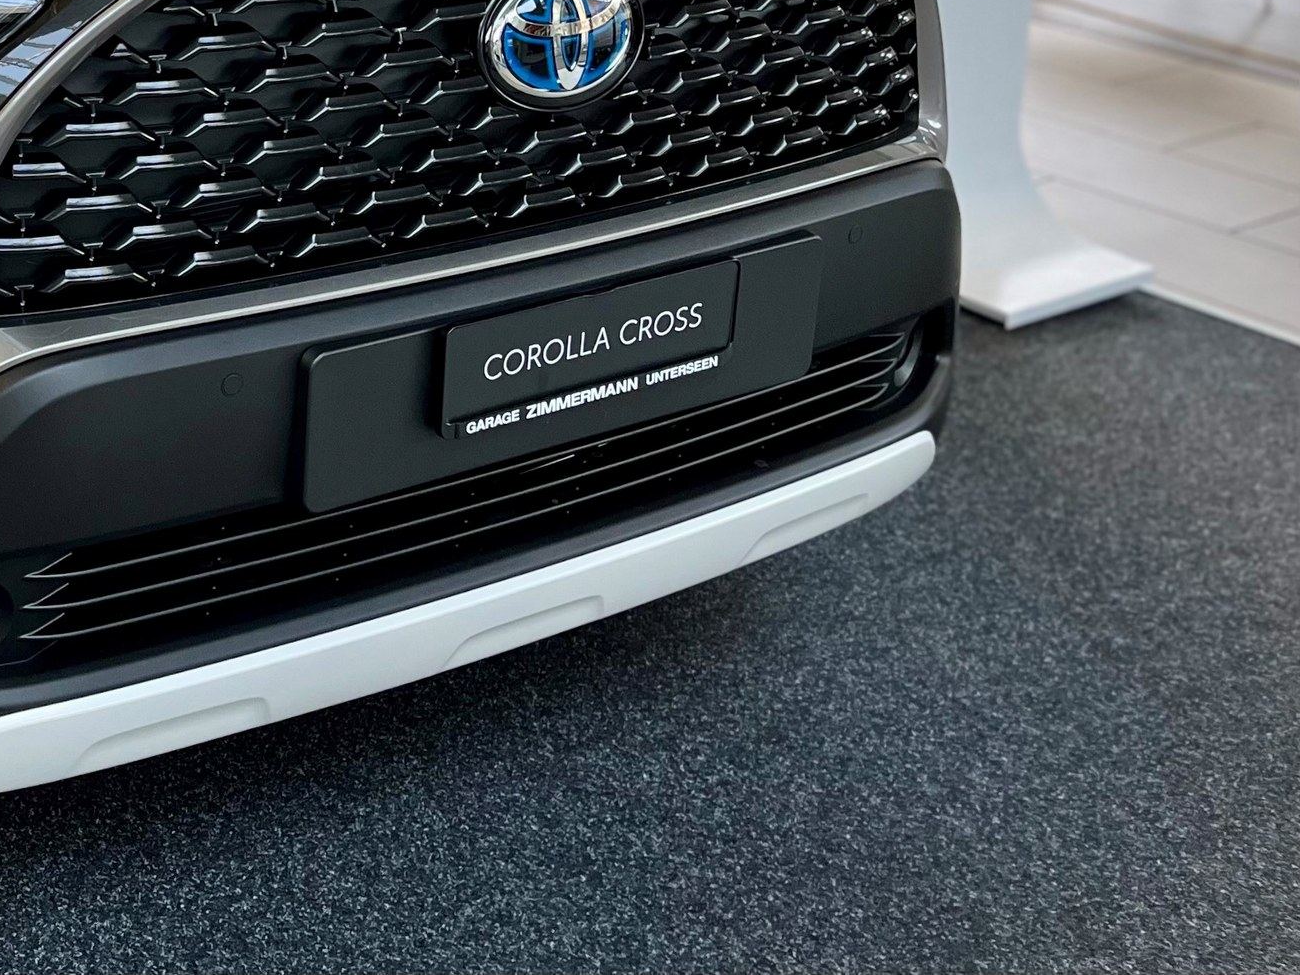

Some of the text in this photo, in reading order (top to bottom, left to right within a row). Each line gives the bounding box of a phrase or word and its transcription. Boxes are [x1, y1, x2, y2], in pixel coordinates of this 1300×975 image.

[484, 302, 703, 380] COROLLA CROSS
[466, 356, 718, 434] GARAGE ZIMMERMANN UNTERSEEN
